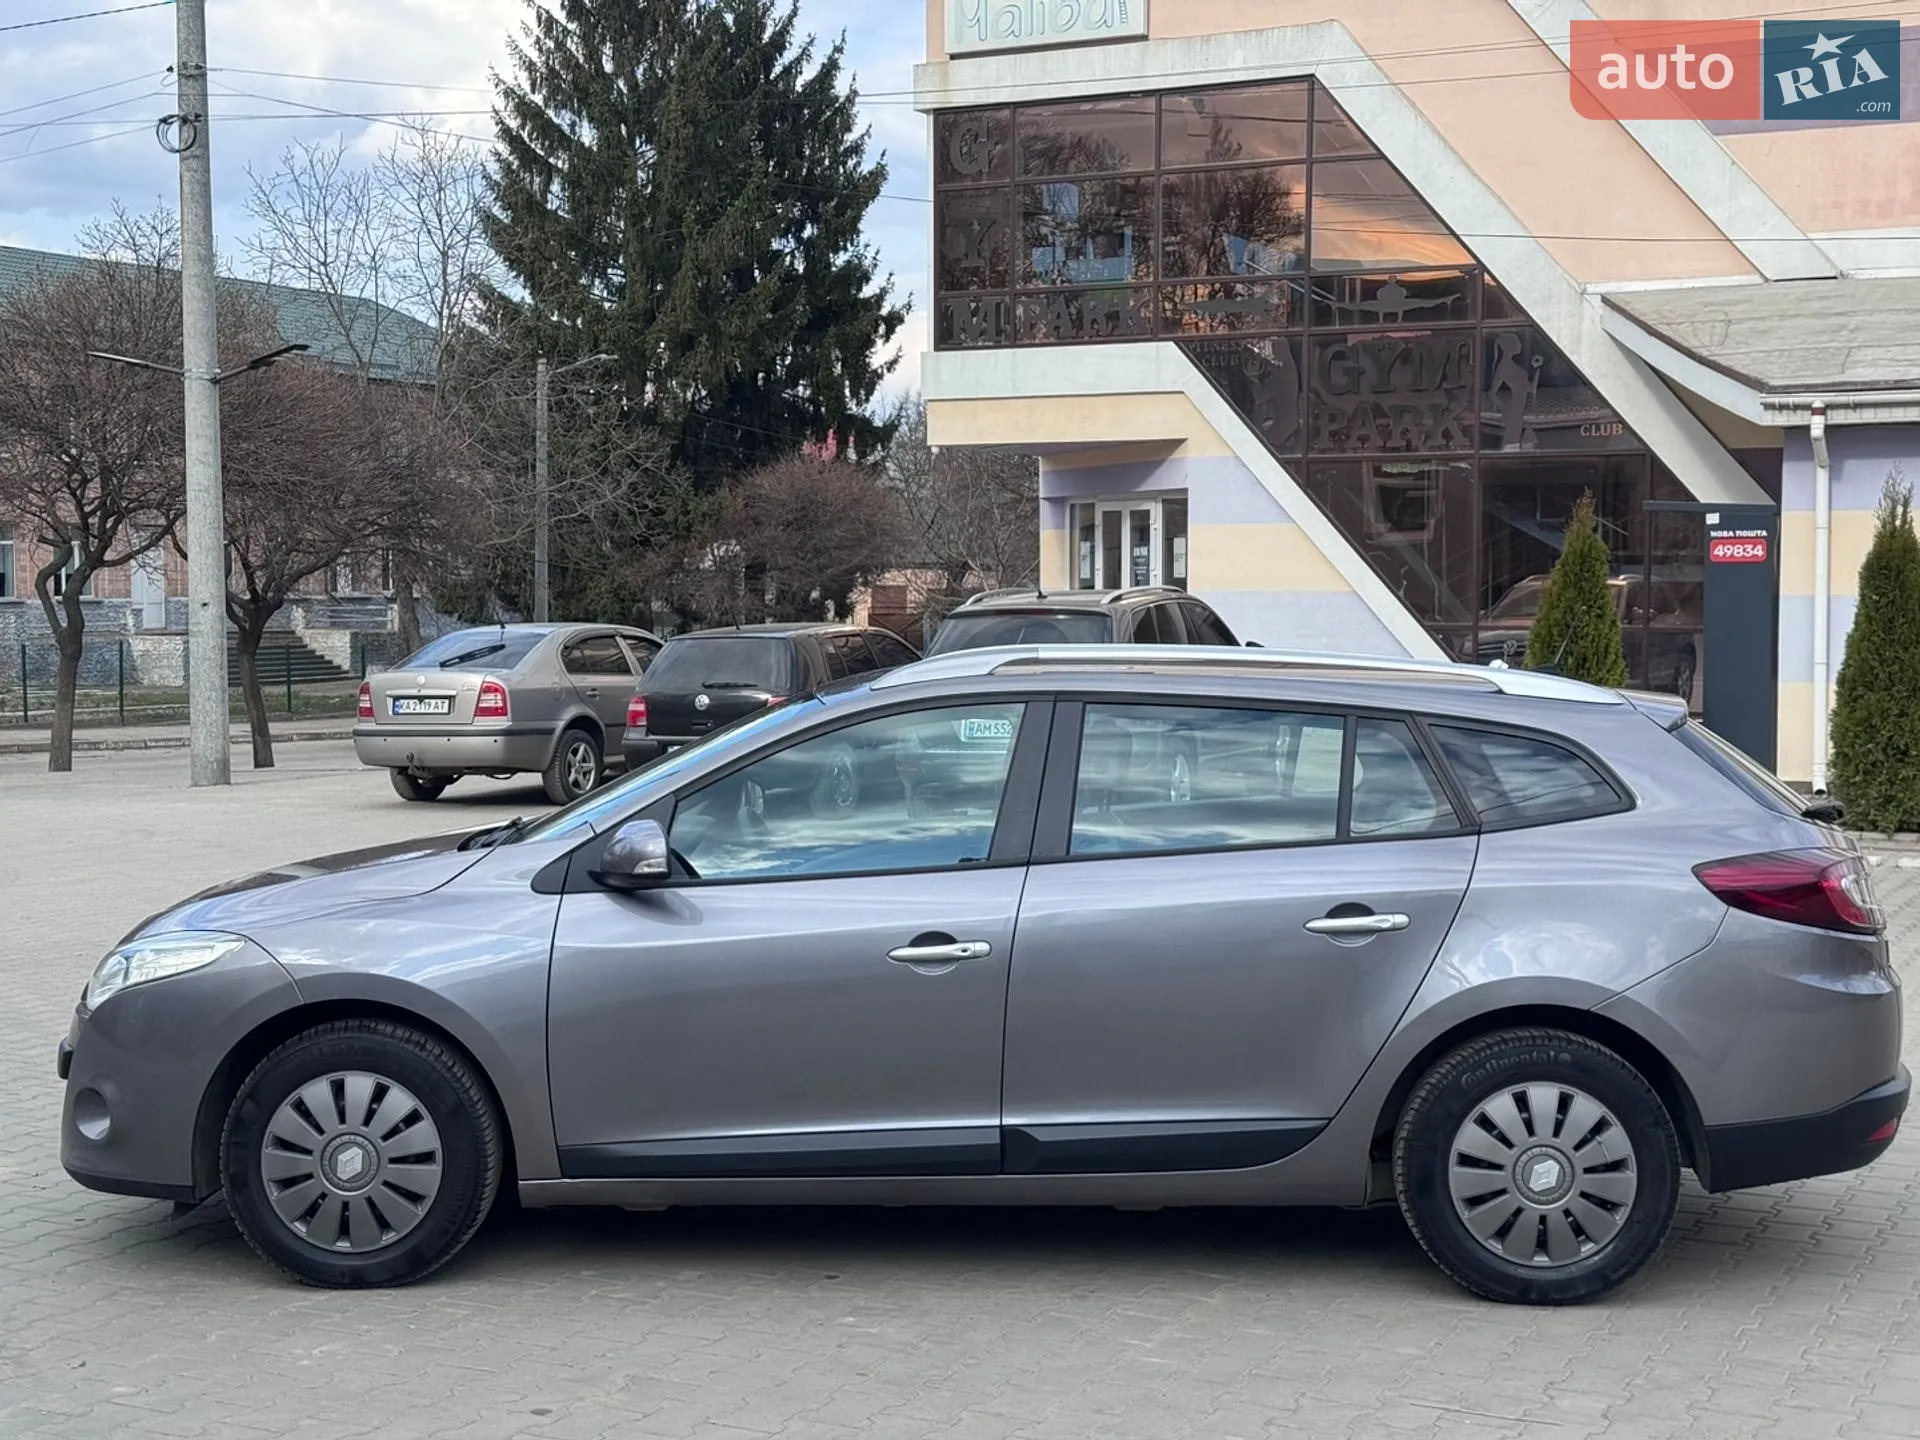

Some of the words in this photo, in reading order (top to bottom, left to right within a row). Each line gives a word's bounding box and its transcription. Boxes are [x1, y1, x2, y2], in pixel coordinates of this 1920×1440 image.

[1316, 338, 1472, 395] GYM
[1316, 403, 1470, 449] PARK
[1580, 423, 1624, 436] CLUB
[1713, 544, 1764, 557] 49834
